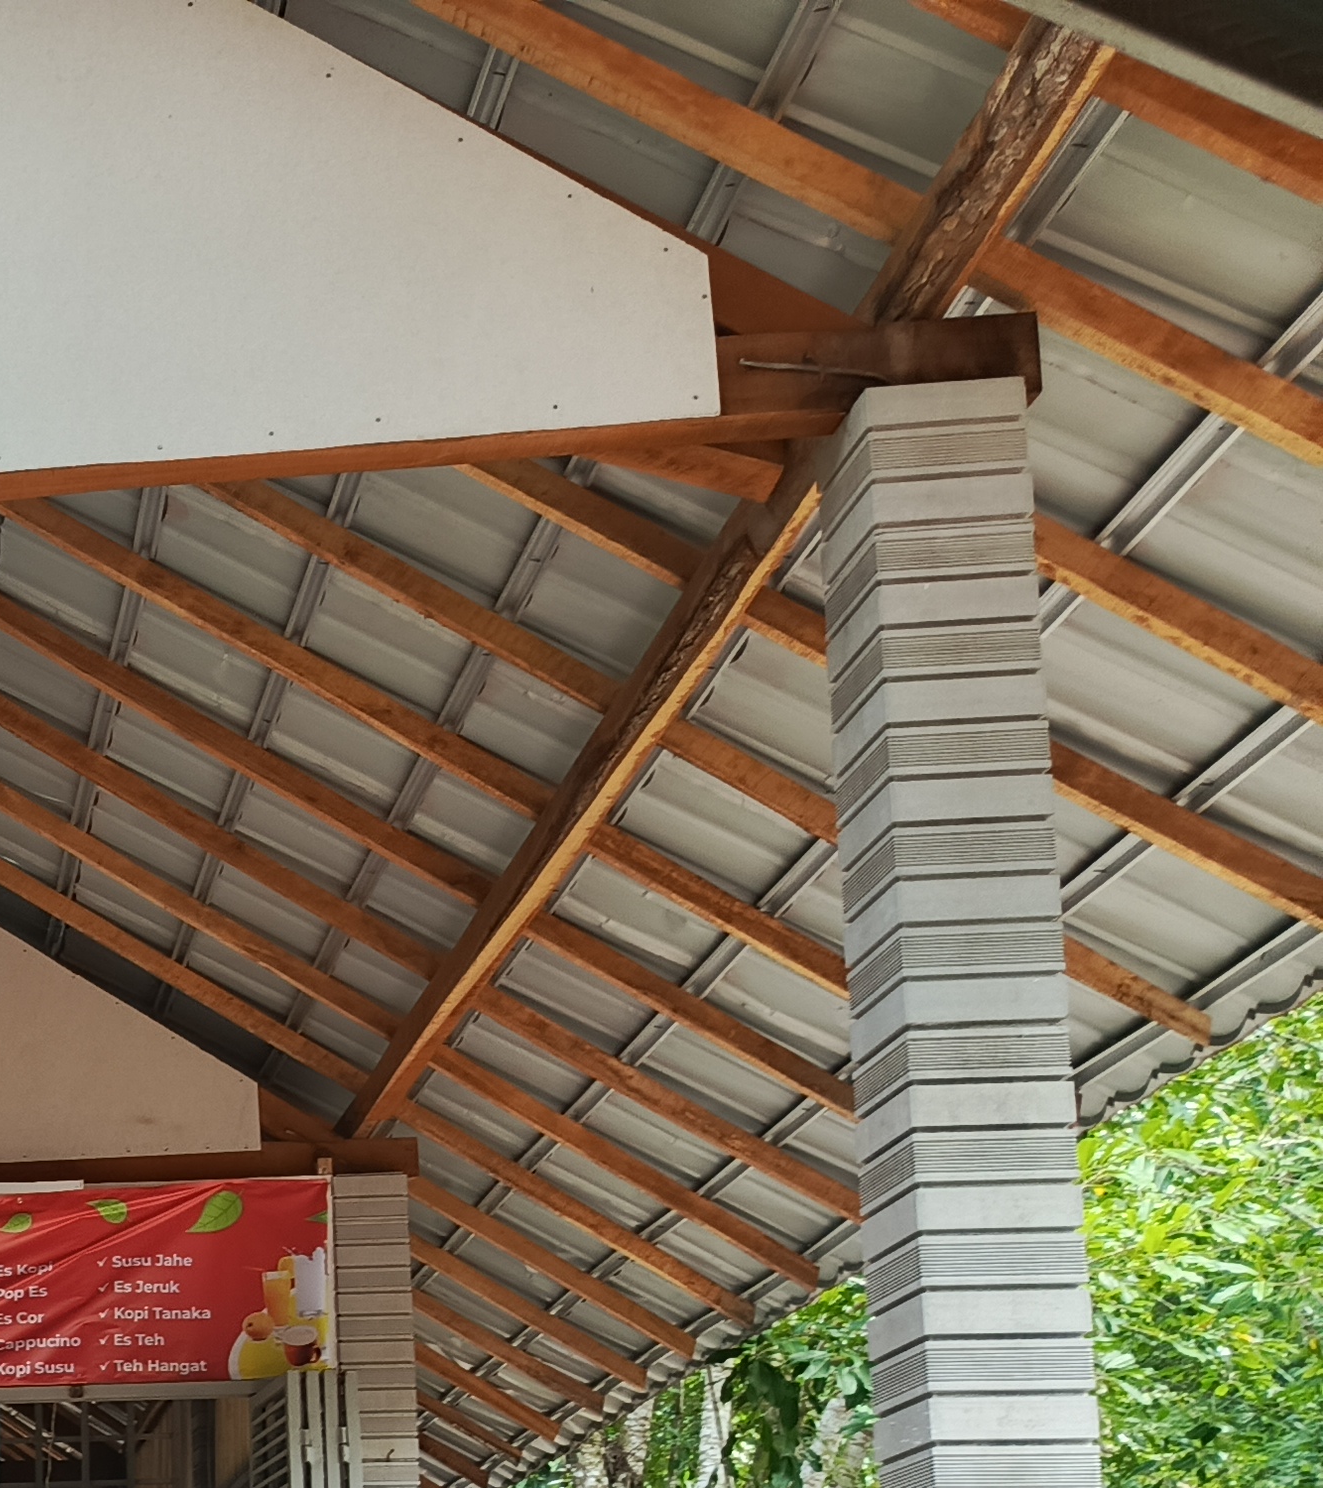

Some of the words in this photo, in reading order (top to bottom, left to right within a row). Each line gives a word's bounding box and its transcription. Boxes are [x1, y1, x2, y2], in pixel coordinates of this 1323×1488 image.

[112, 1256, 151, 1267] Susu
[155, 1254, 192, 1266] Jahe
[16, 1260, 53, 1275] Kopi
[25, 1286, 48, 1297] Es
[115, 1281, 132, 1293] Es
[135, 1281, 179, 1293] Jeruk
[16, 1312, 45, 1324] Cor
[114, 1306, 148, 1322] Kopi
[152, 1307, 211, 1319] Tanaka
[114, 1334, 131, 1345] Es
[135, 1333, 164, 1345] Teh
[34, 1362, 74, 1374] Susu
[113, 1359, 143, 1371] Teh
[148, 1360, 207, 1374] Hangat
